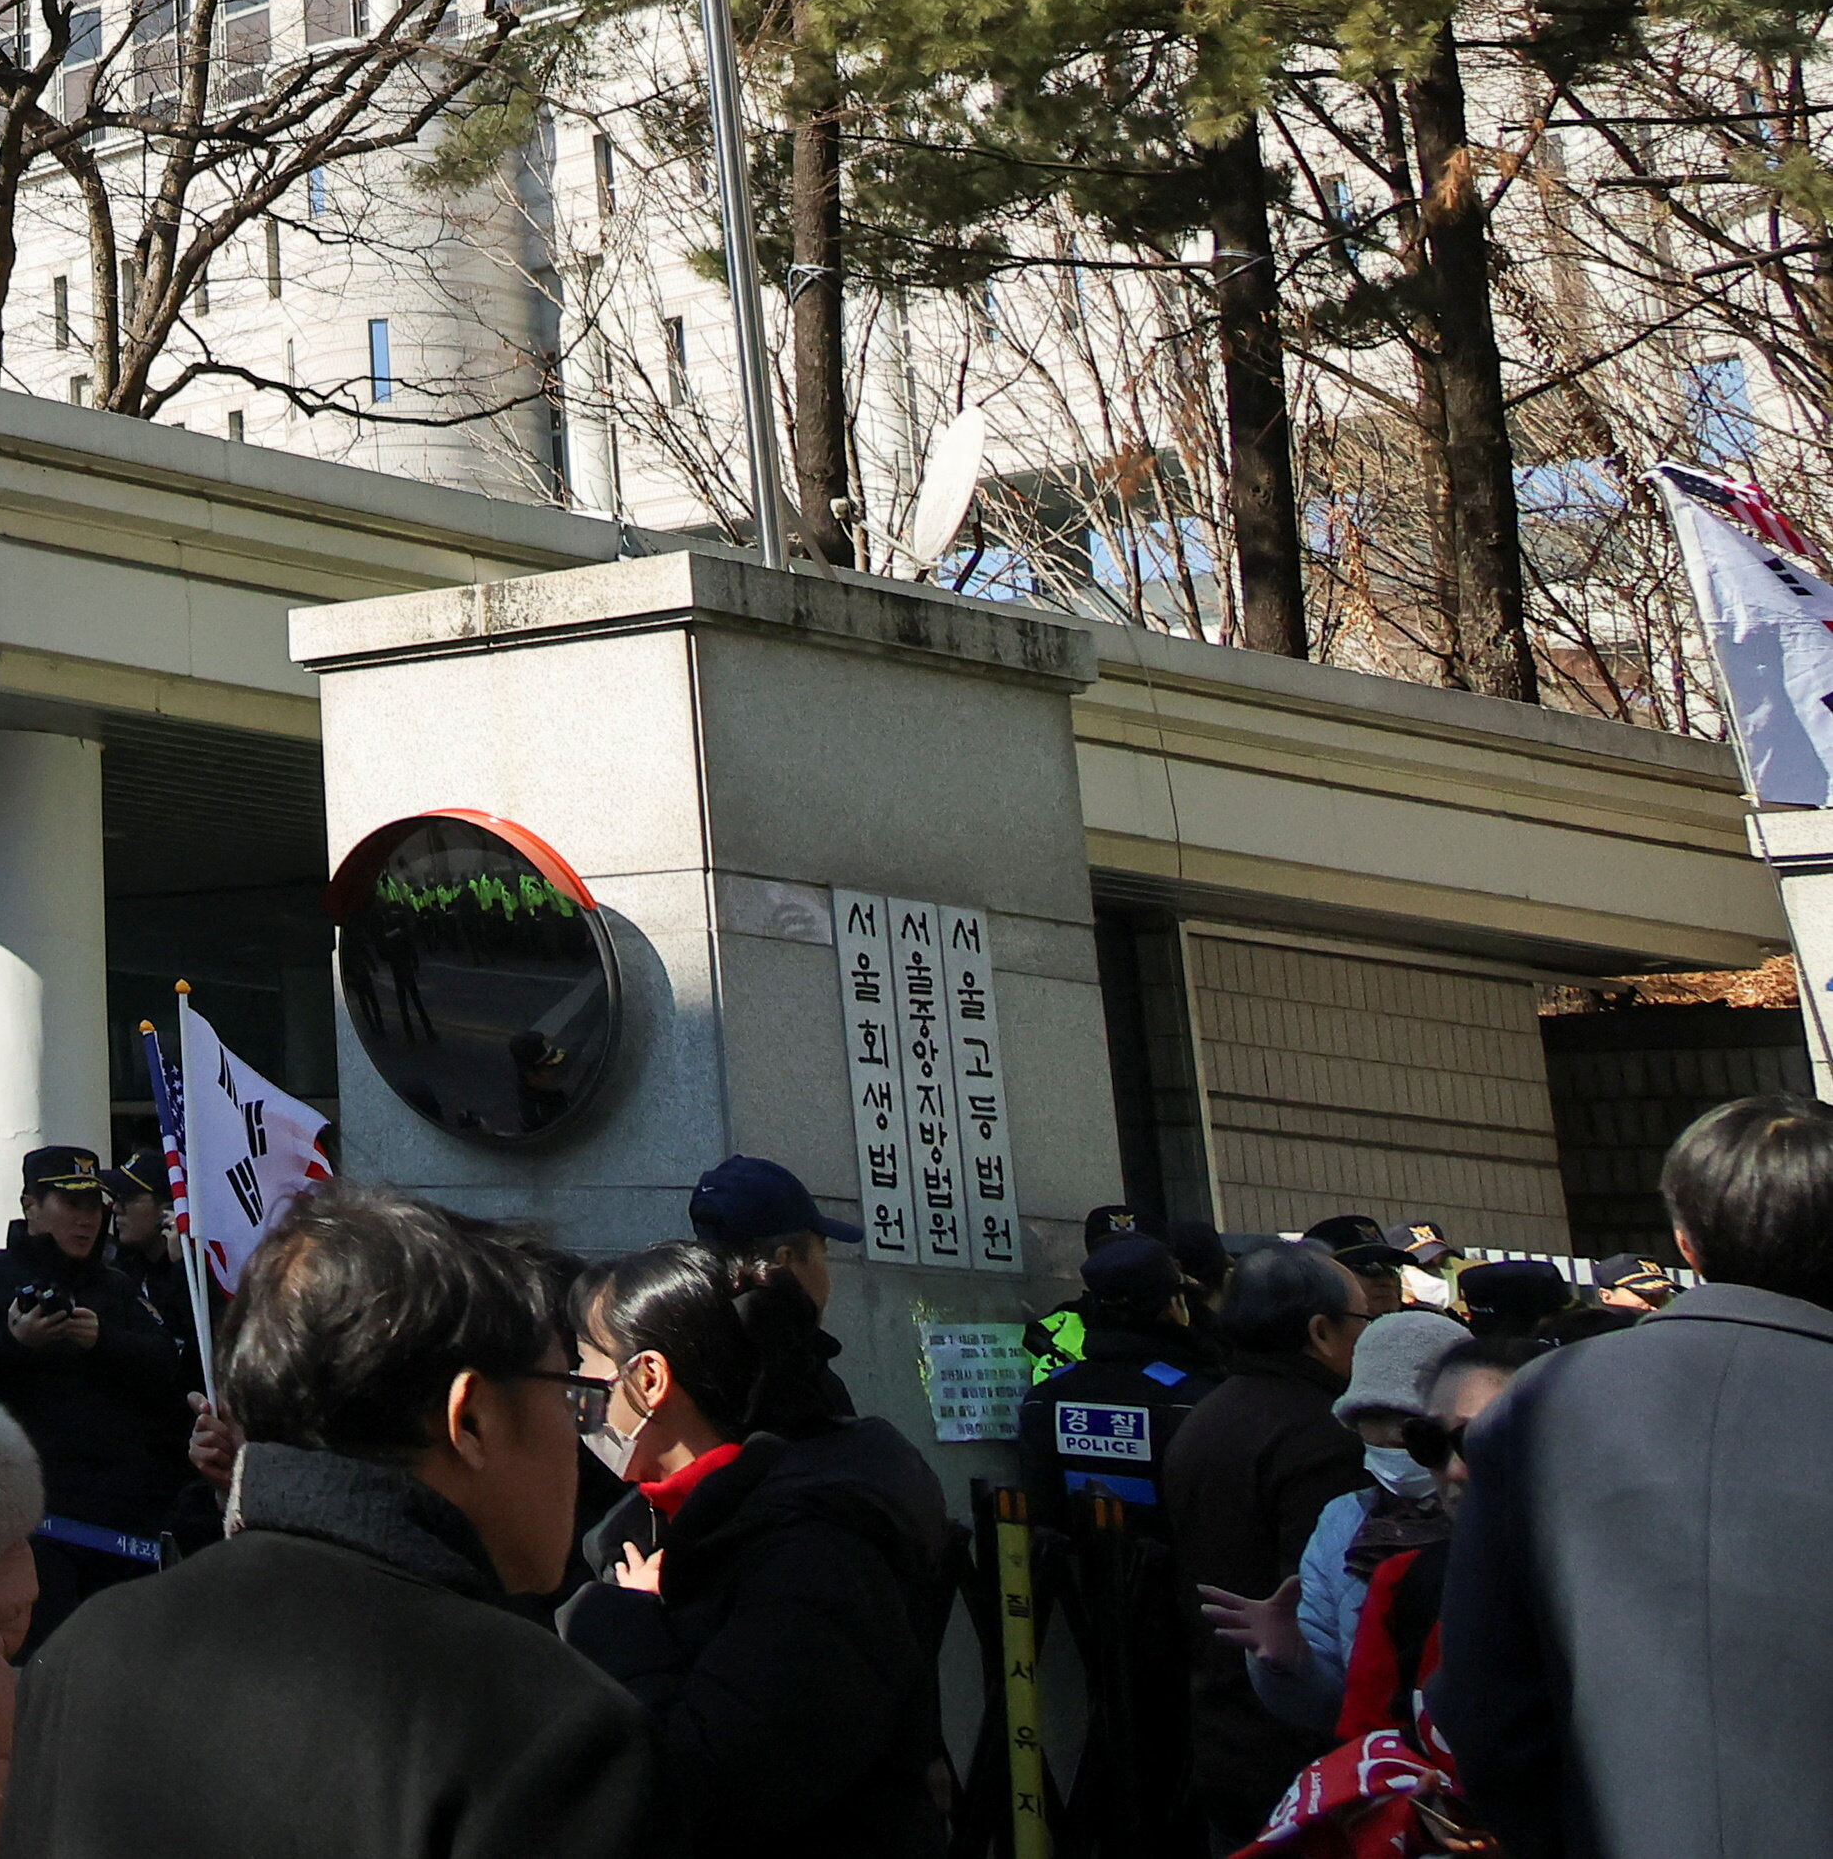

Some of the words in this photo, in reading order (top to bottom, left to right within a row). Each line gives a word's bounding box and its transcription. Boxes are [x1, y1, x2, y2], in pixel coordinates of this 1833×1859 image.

[848, 903, 904, 1251] 서울회생법원
[901, 911, 958, 1256] 서울중앙지방법원
[953, 918, 1013, 1262] 서울고등법원
[1065, 1437, 1138, 1454] POLICE
